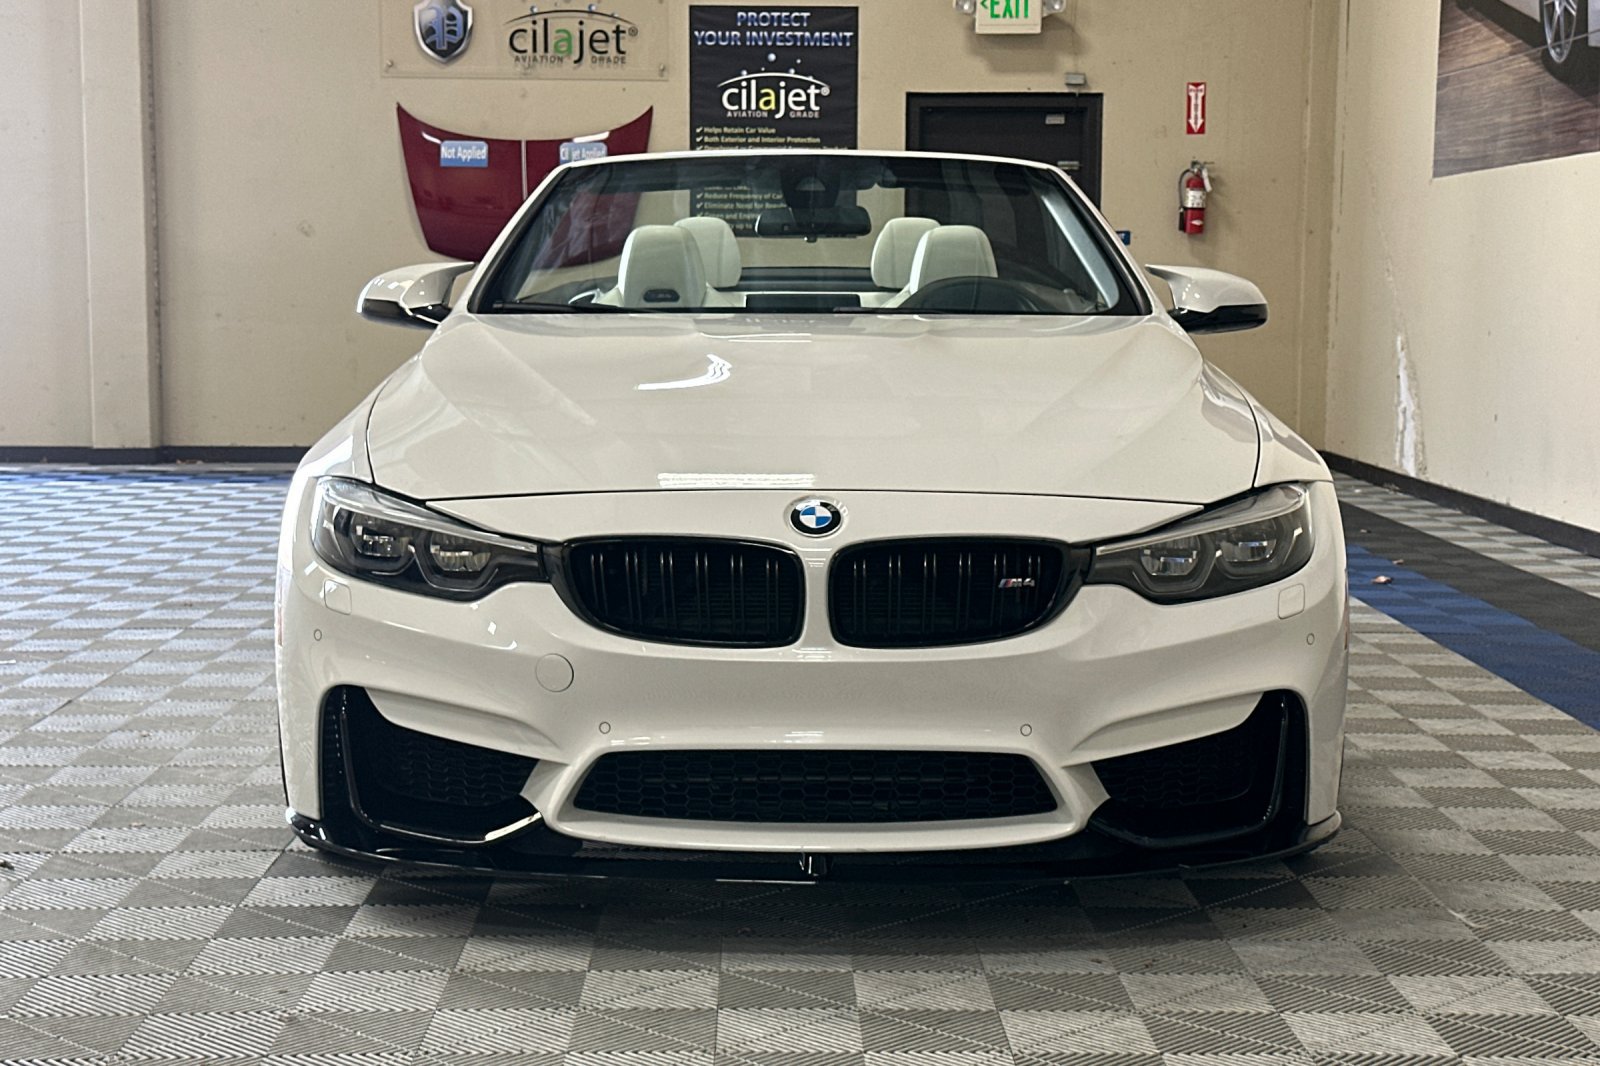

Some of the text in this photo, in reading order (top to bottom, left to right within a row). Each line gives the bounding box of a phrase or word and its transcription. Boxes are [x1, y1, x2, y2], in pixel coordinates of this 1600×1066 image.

[737, 11, 811, 27] PROTECT
[694, 30, 853, 47] YOUR INVESTMENT
[514, 55, 564, 63] AVIATION
[441, 146, 486, 162] Not Applied
[729, 192, 762, 201] Frequency
[998, 577, 1035, 588] M4
